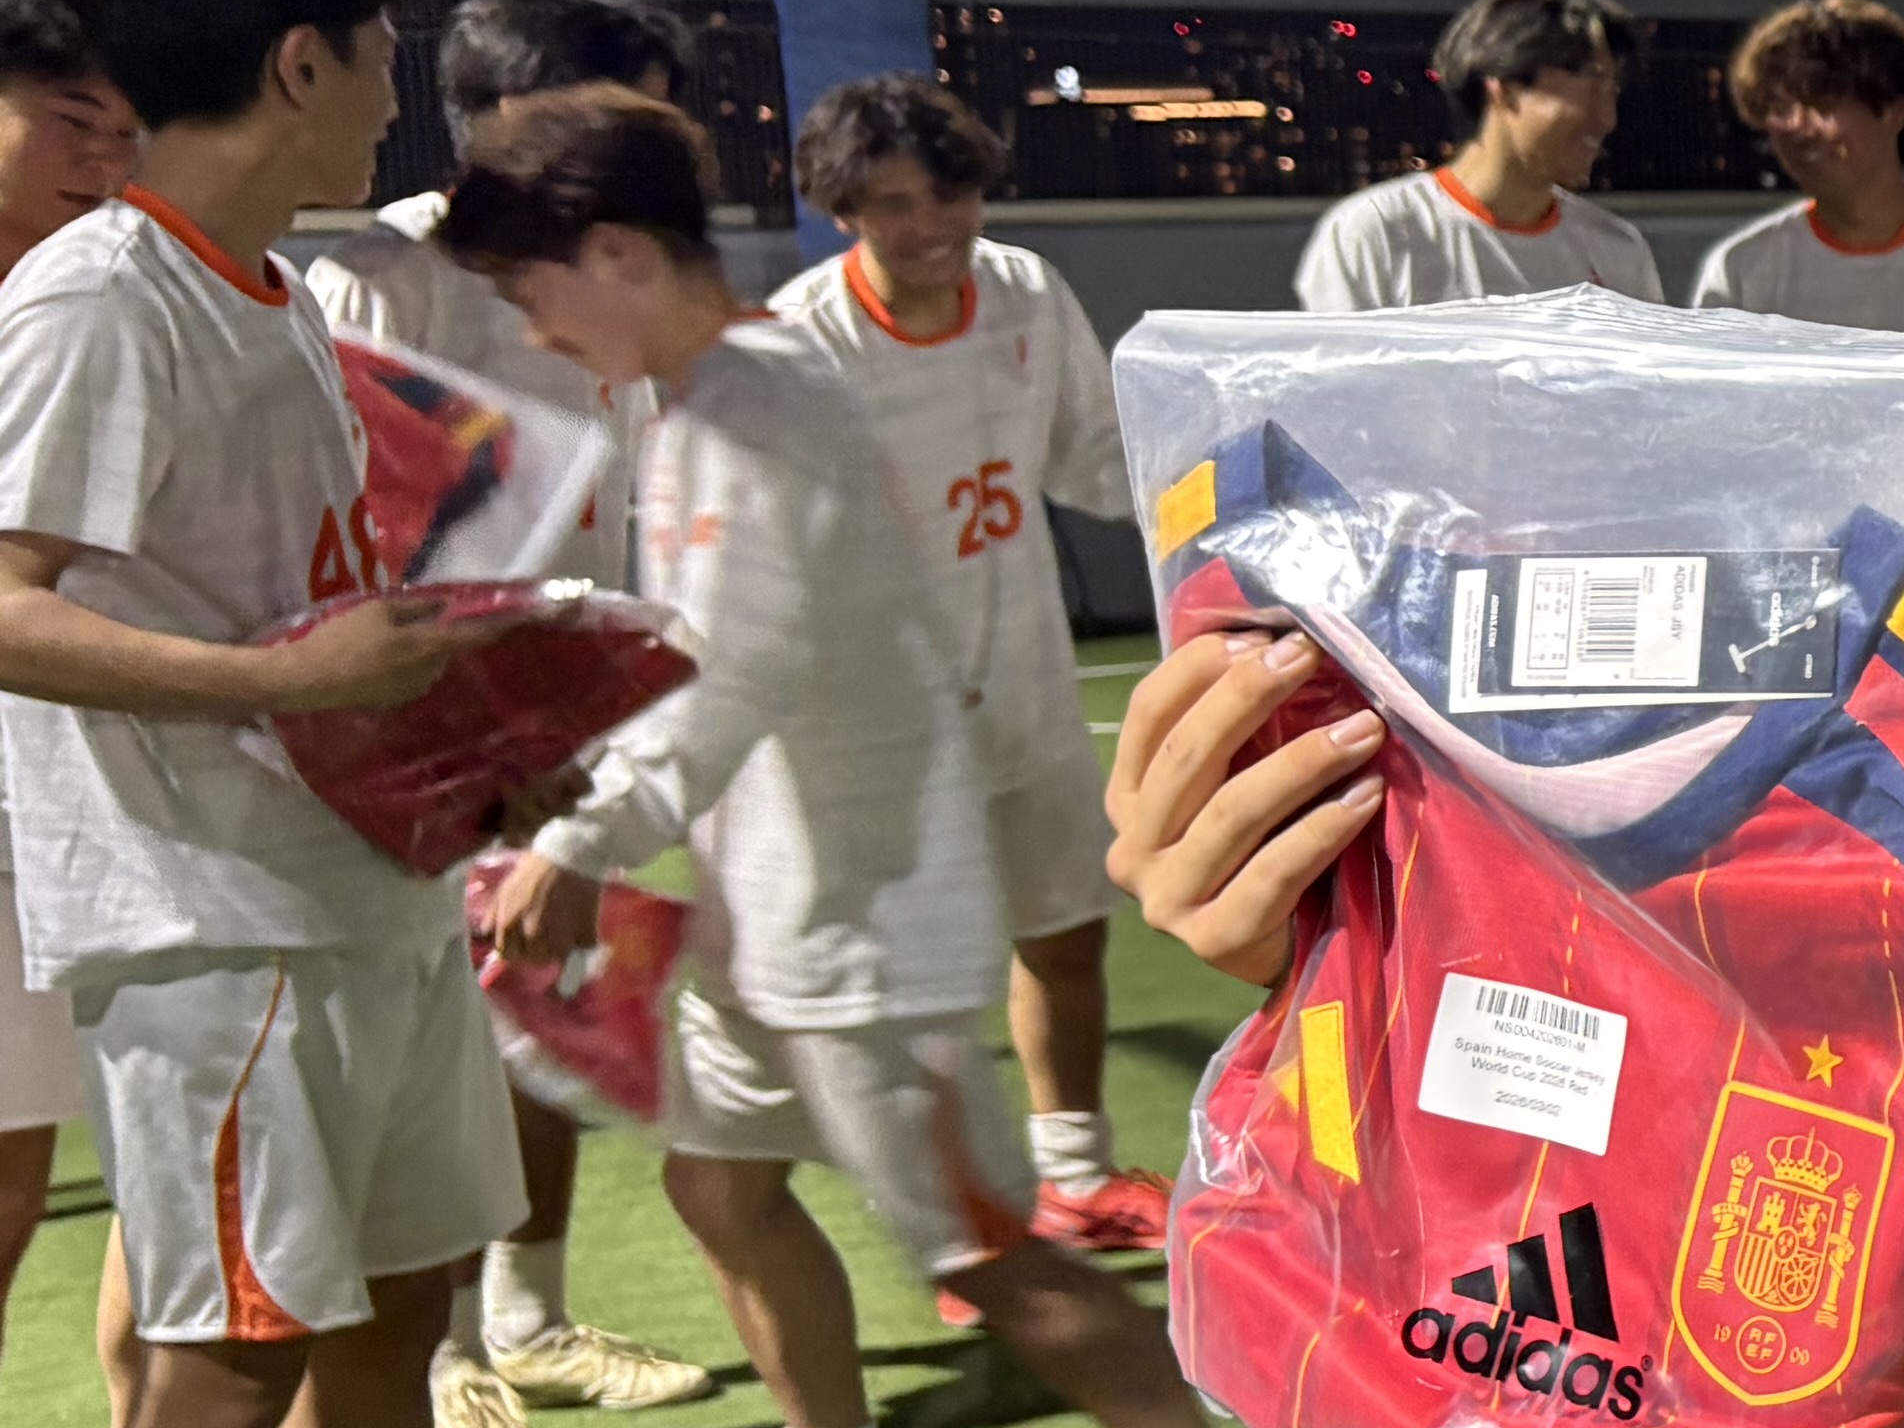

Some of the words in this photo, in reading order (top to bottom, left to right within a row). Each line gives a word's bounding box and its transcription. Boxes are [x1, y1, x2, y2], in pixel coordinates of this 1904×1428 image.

[947, 457, 1023, 557] 25
[1454, 1037, 1493, 1058] Spain
[1496, 1047, 1532, 1064] Home
[1471, 1056, 1508, 1076] World
[1401, 1307, 1645, 1421] adidas
